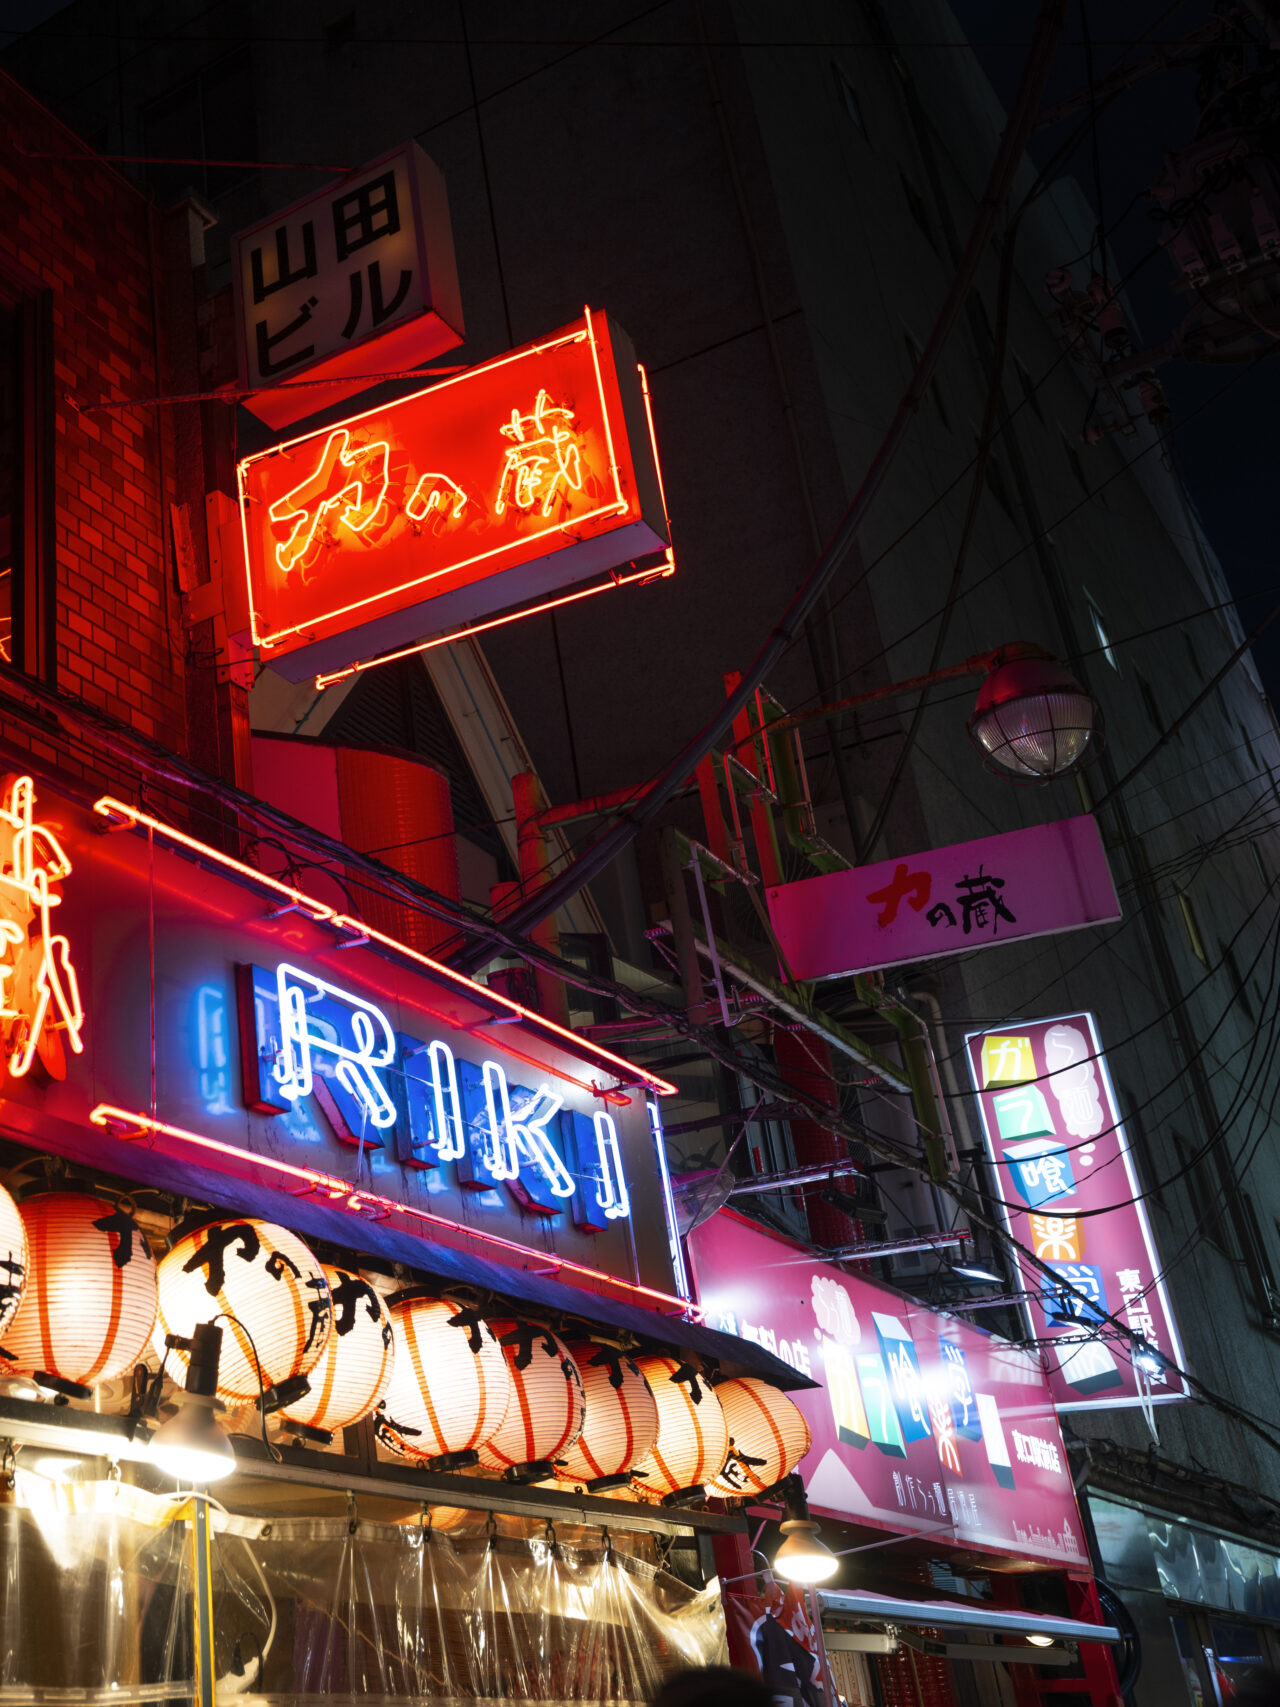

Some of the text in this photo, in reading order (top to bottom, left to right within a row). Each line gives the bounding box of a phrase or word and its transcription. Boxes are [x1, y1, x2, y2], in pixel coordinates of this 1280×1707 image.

[250, 169, 402, 305] 山田
[255, 259, 413, 378] ビル
[268, 390, 582, 571] 力の蔵
[865, 863, 1017, 935] 力の蔵
[240, 962, 631, 1232] RIKI
[182, 1223, 331, 1354] 力の蔵
